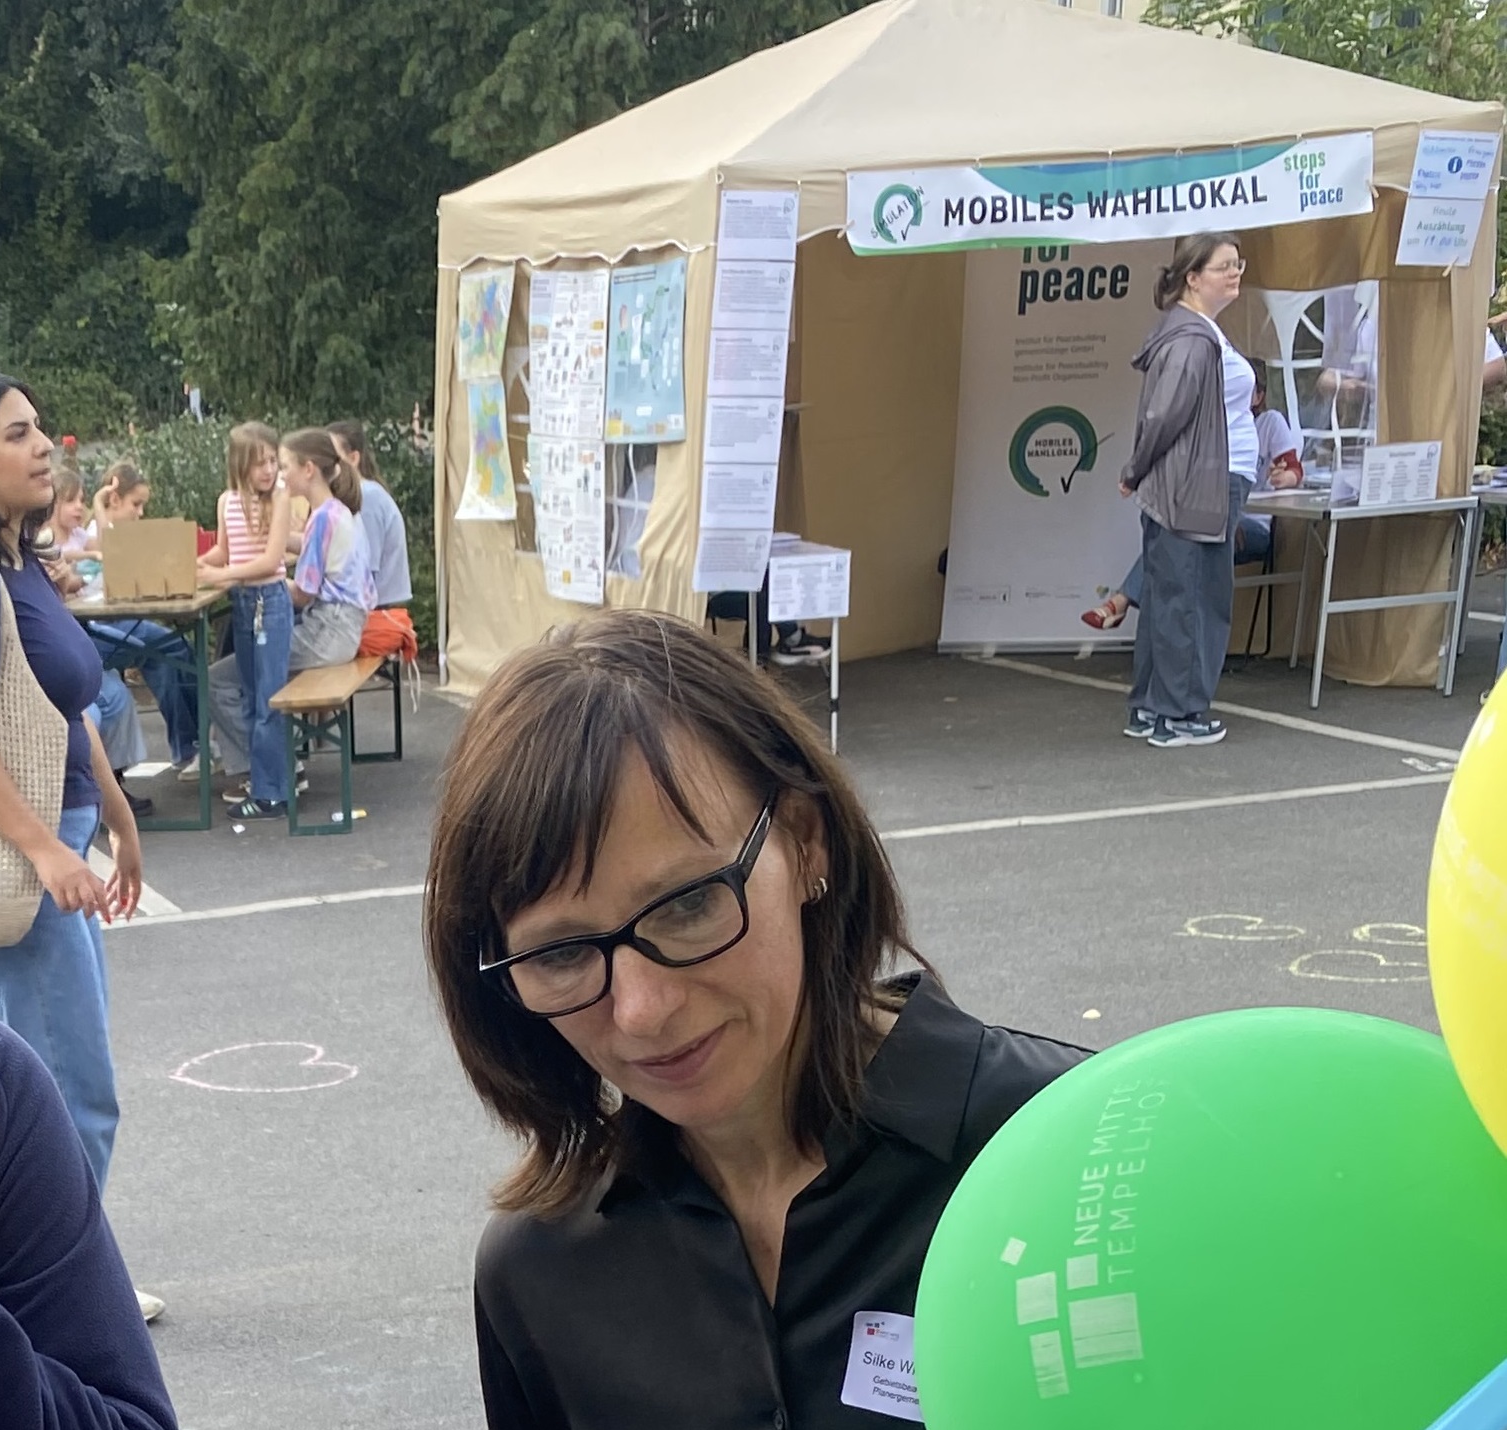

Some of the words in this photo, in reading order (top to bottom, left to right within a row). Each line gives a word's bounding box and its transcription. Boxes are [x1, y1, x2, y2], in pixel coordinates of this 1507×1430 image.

[1284, 151, 1326, 173] steps
[1298, 171, 1321, 191] for
[944, 190, 1074, 227] MOBILES
[1087, 175, 1268, 219] WAHLLOKAL
[1300, 187, 1343, 213] peace
[1018, 264, 1130, 316] peace
[1035, 438, 1073, 448] MOBILES
[1089, 1078, 1142, 1157] MITTE
[1074, 1162, 1109, 1246] NEUE
[862, 1351, 895, 1370] Silke
